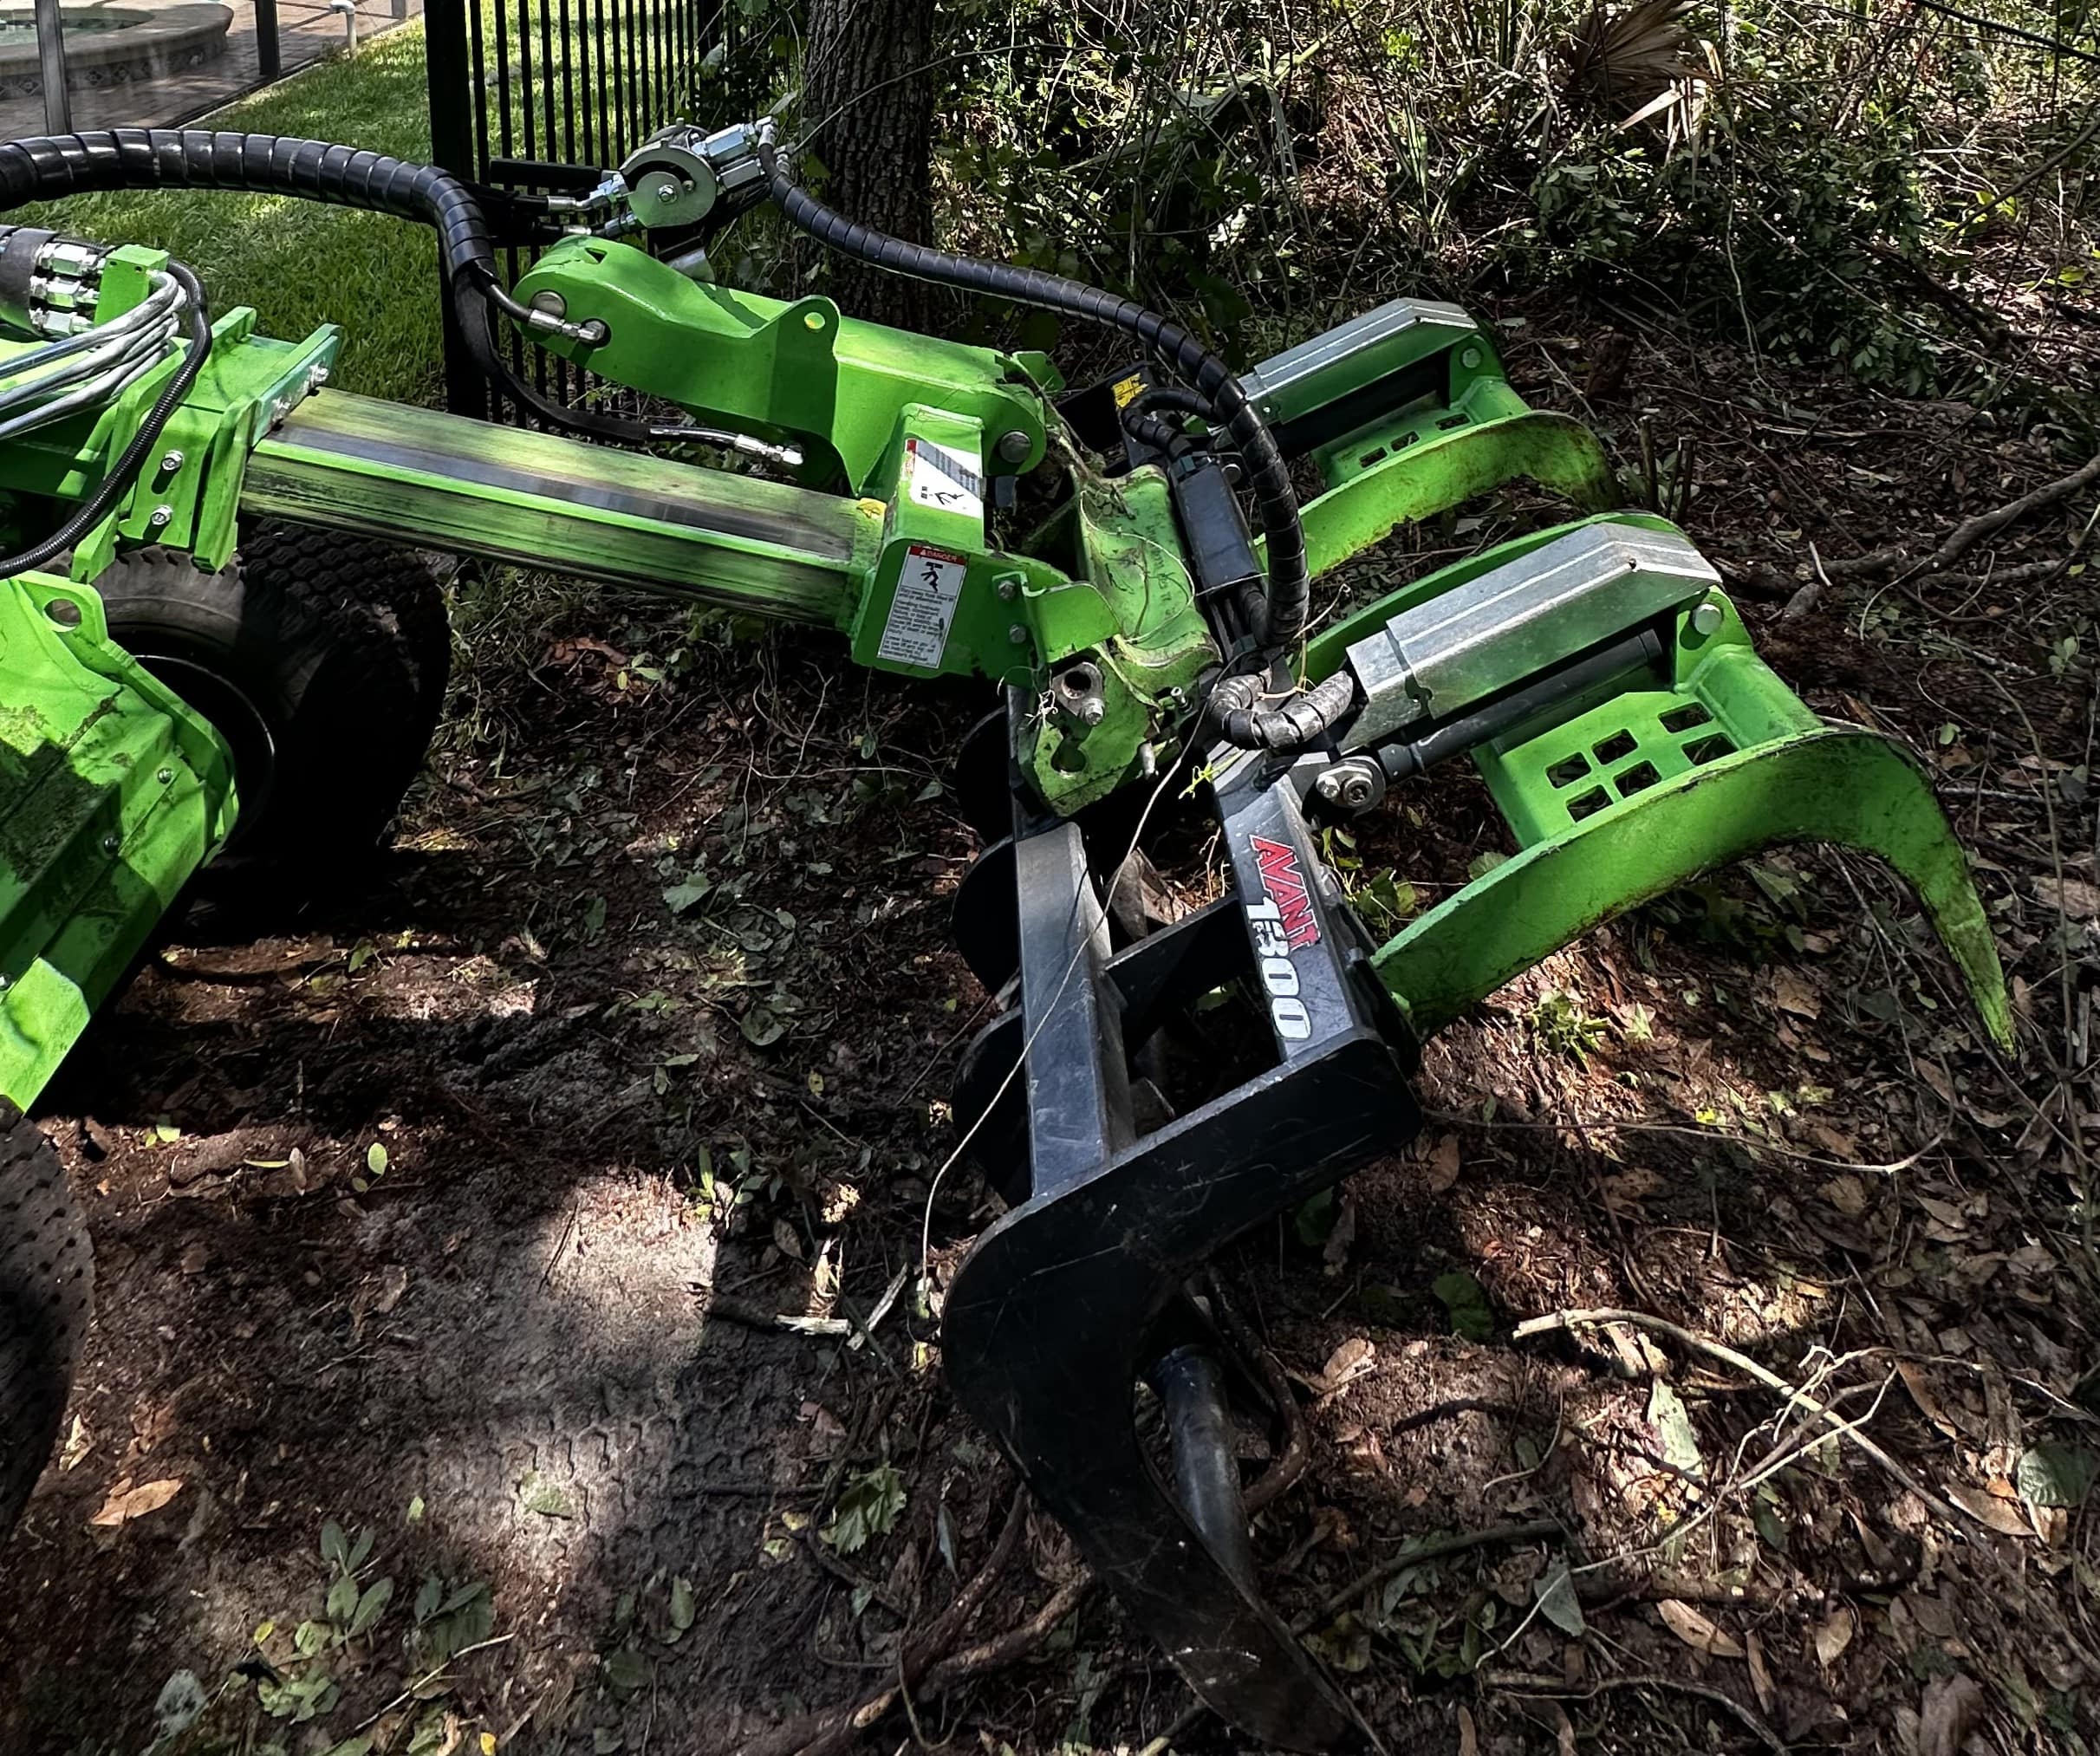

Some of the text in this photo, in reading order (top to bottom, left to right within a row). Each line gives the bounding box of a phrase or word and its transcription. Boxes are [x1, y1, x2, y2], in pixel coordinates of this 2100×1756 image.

[926, 550, 958, 562] DANGER
[1249, 835, 1322, 952] AVANT
[1246, 896, 1311, 1039] 1300
